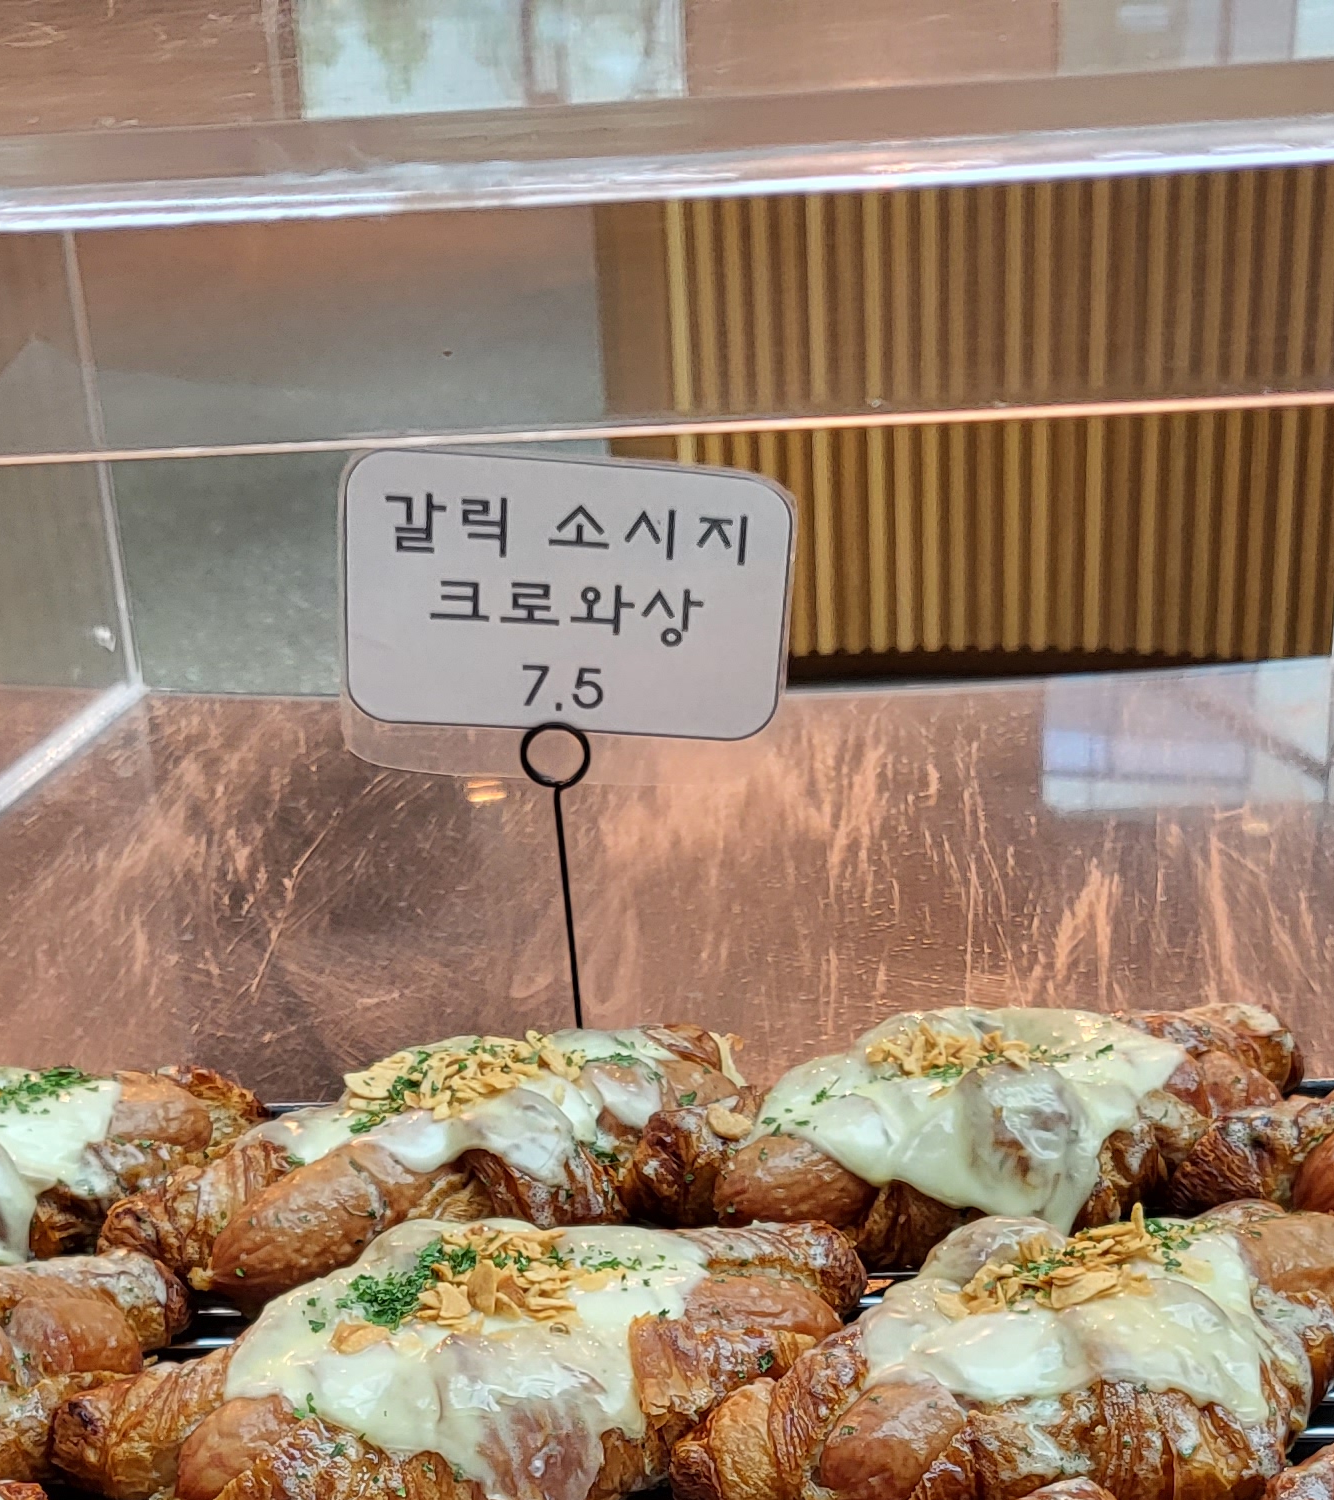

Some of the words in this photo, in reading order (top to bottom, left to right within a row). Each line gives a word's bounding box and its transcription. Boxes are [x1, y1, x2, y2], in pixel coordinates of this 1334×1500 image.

[384, 492, 509, 558] 갈릭
[548, 504, 748, 566] 소시지
[429, 580, 704, 648] 크로와상
[522, 664, 604, 712] 7.5
